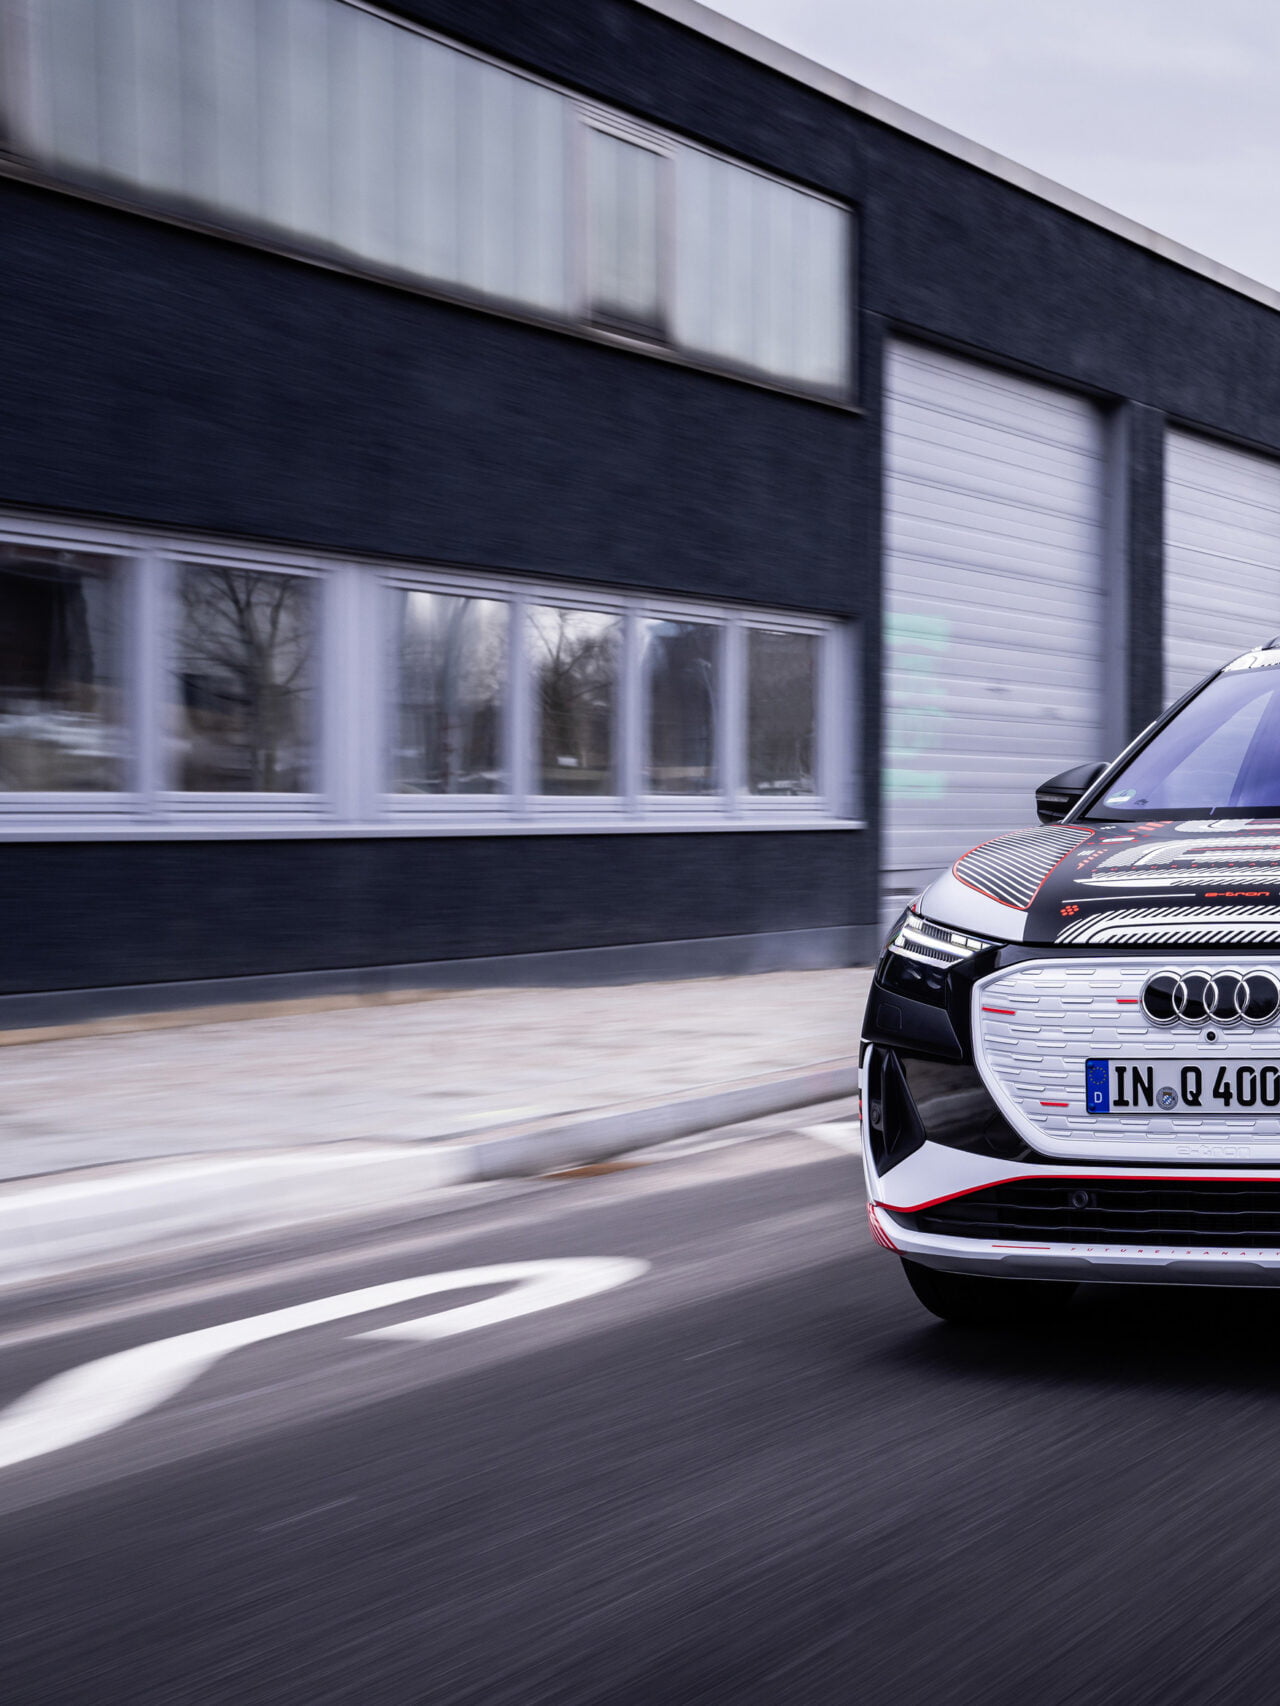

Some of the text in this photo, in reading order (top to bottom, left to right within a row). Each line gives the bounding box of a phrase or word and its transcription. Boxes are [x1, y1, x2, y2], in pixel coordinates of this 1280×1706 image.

[1112, 1065, 1154, 1107] IN
[1180, 1065, 1203, 1107] Q
[1093, 1091, 1103, 1104] D
[1176, 1144, 1251, 1158] e-tron
